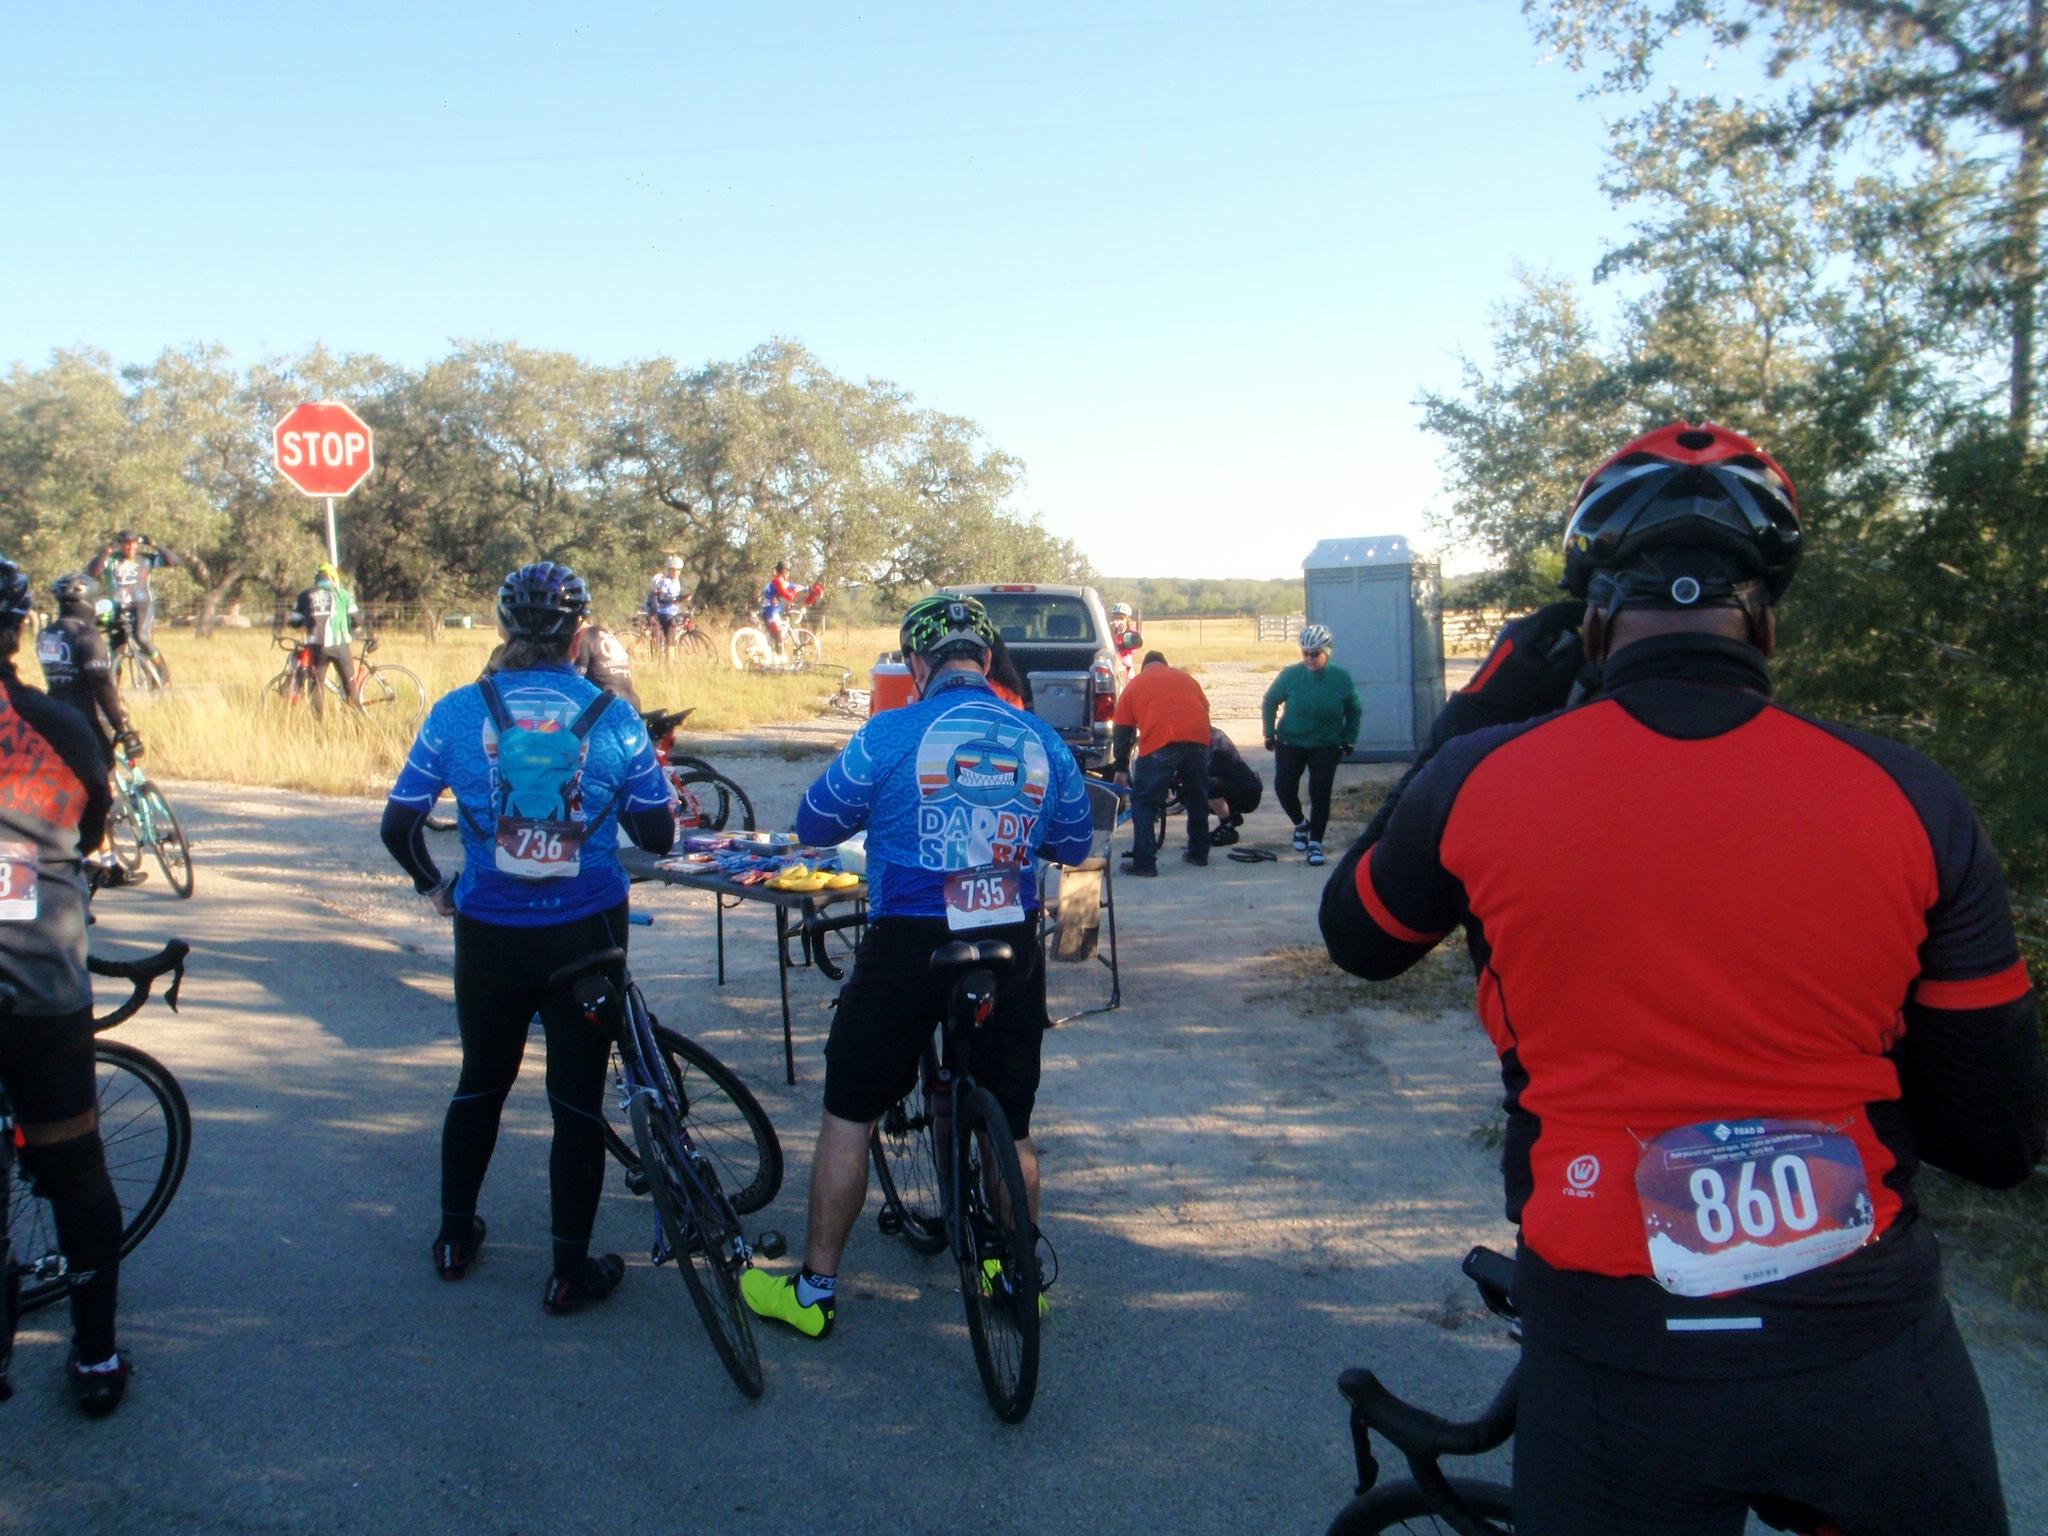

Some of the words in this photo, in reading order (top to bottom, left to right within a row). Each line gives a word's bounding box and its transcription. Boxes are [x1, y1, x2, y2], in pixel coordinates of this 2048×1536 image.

[282, 431, 365, 467] STOP
[918, 805, 1038, 843] DADDY
[516, 828, 563, 860] 736
[961, 876, 1006, 910] 735
[1733, 1127, 1756, 1136] ROAD
[1689, 1153, 1820, 1245] 860
